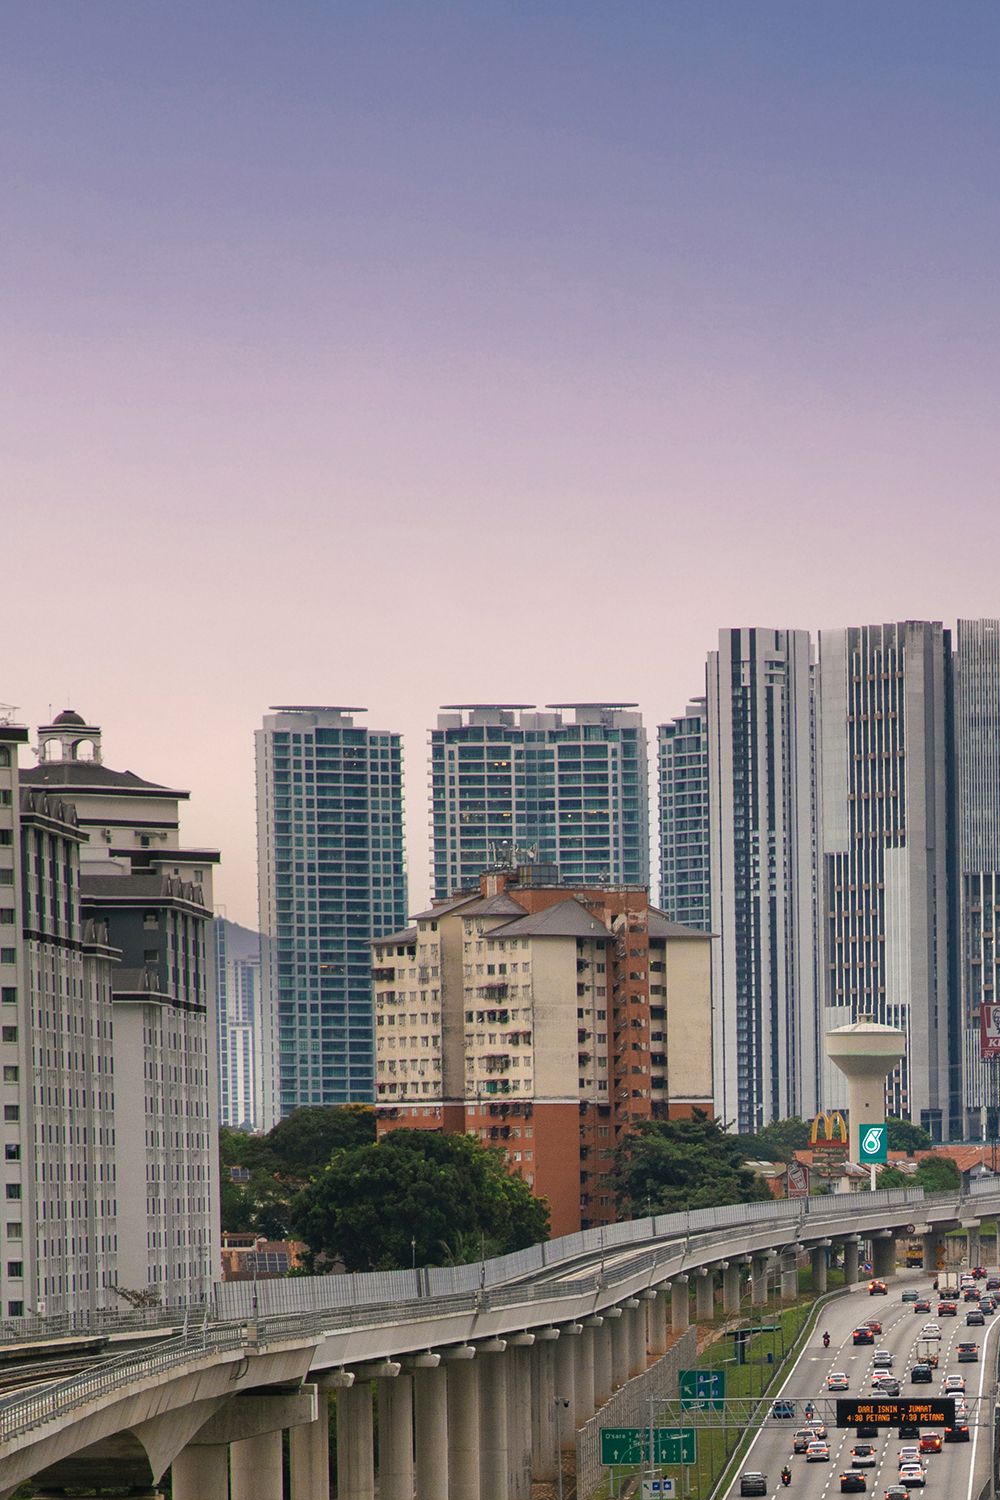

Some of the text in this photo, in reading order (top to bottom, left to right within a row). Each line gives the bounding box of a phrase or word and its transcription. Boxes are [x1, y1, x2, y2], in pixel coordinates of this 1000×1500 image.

[858, 1405, 874, 1413] DARI
[878, 1405, 898, 1413] ISNIN
[908, 1405, 932, 1413] JUMAAT
[847, 1414, 863, 1422] 4:30
[866, 1414, 890, 1422] PETANG
[901, 1413, 917, 1421] 7:30
[920, 1413, 944, 1421] PETANG
